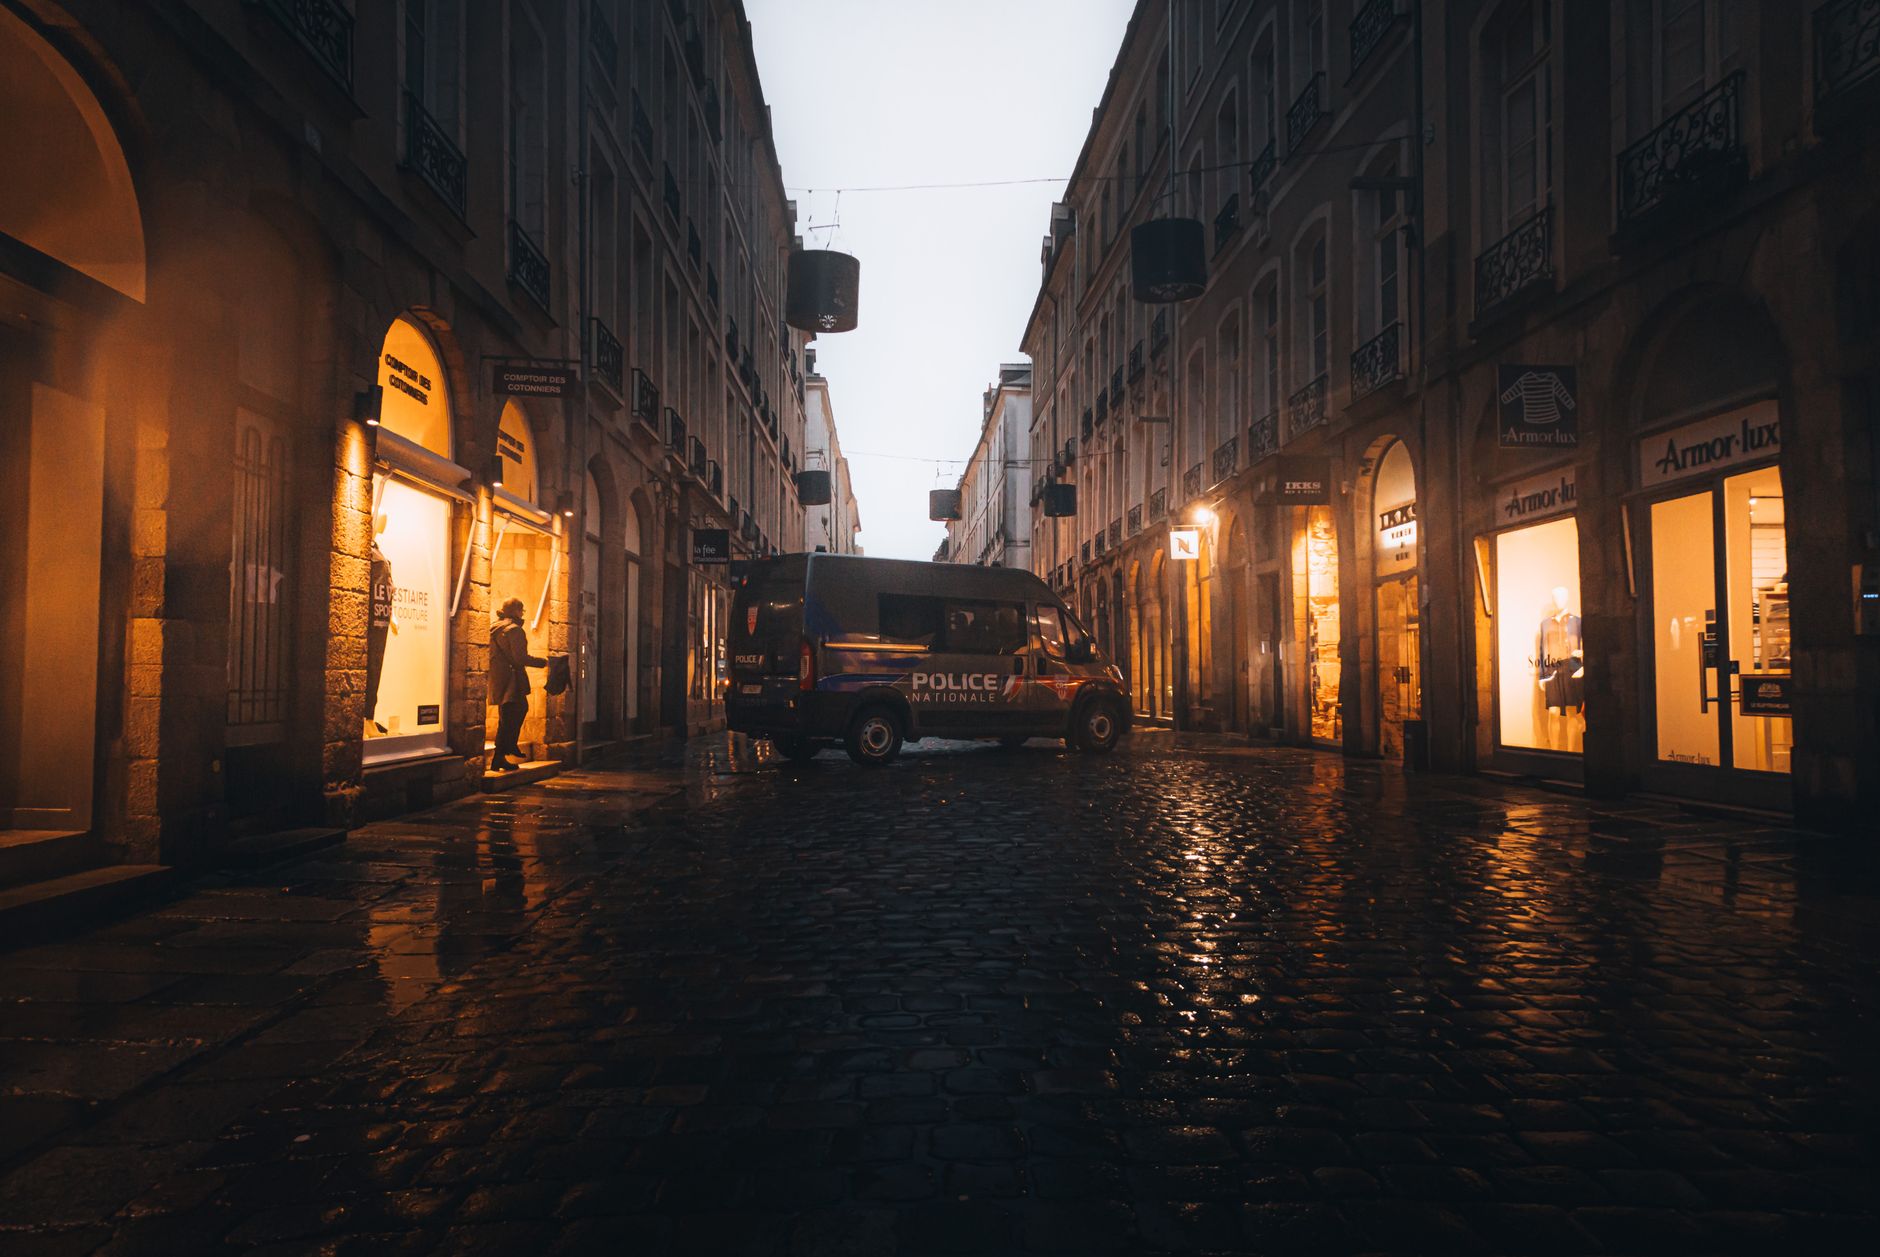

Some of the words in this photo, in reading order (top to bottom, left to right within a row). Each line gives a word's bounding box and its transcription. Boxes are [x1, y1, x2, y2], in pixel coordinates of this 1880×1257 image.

[503, 373, 547, 383] COMPTOIR
[549, 376, 566, 384] DES
[507, 383, 561, 393] COTONNIERS
[1284, 481, 1321, 490] IKKS
[374, 584, 385, 600] LE
[735, 655, 757, 663] POLICE
[912, 672, 998, 690] POLICE
[912, 692, 995, 702] NATIONALE
